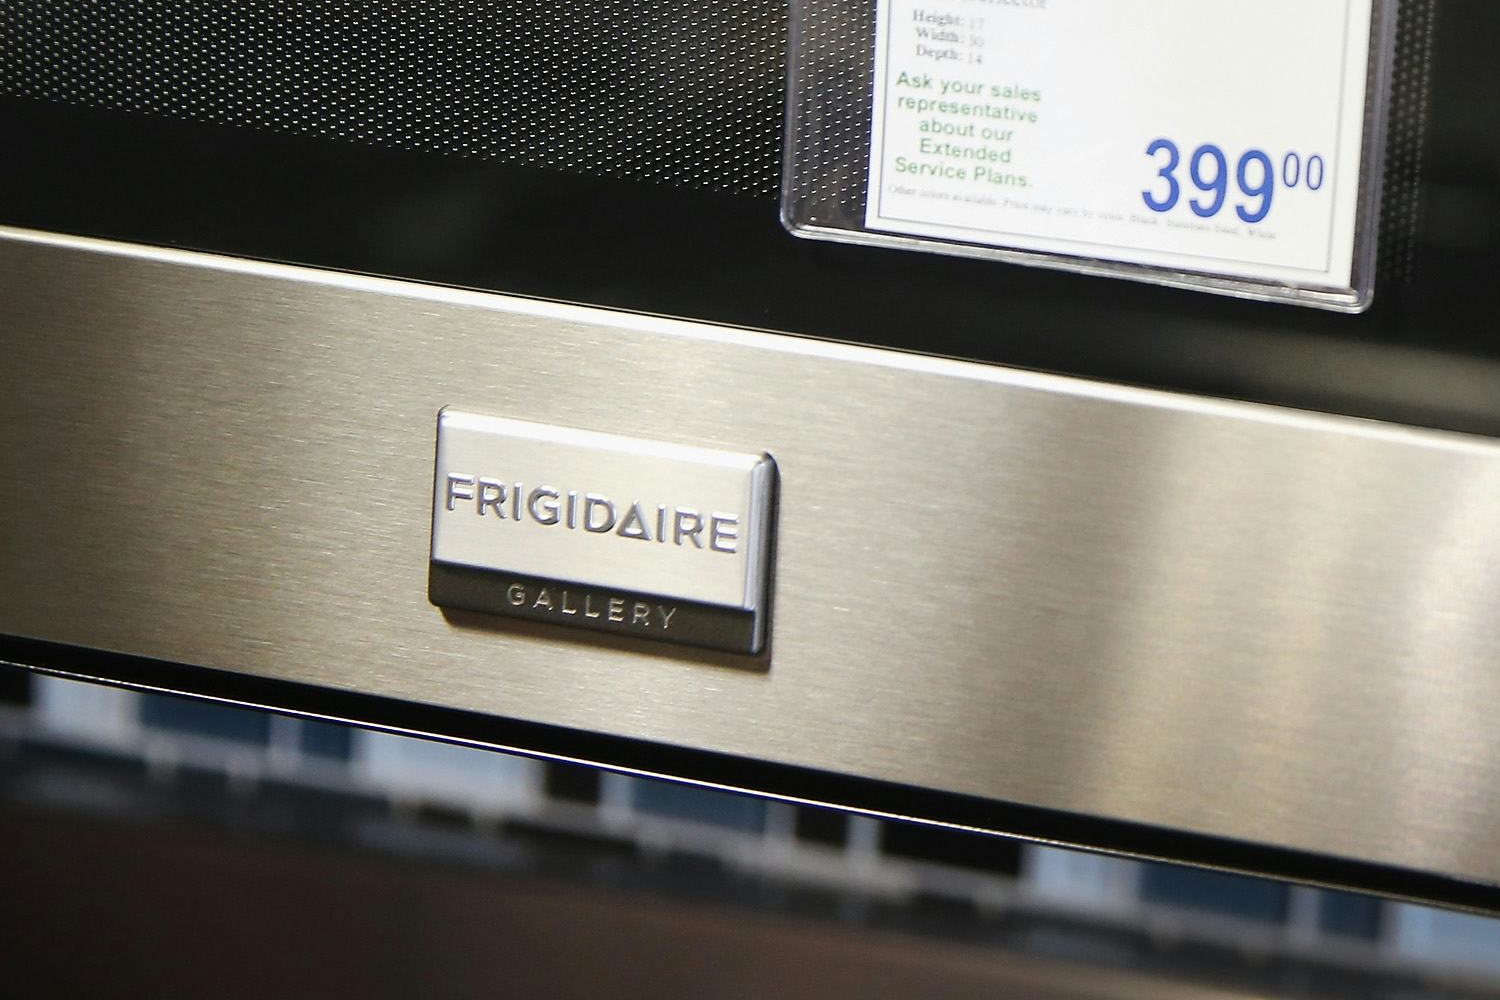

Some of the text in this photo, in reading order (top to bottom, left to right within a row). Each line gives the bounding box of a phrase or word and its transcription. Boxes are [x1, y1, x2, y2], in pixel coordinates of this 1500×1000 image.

[896, 71, 1042, 103] Ask your sales
[897, 96, 1040, 124] representative
[919, 117, 1014, 142] about our
[919, 137, 1012, 164] Extended
[895, 156, 967, 180] Service
[1142, 138, 1275, 224] 399
[446, 472, 739, 554] FRIGIDAIRE
[506, 583, 677, 630] GALLERY
